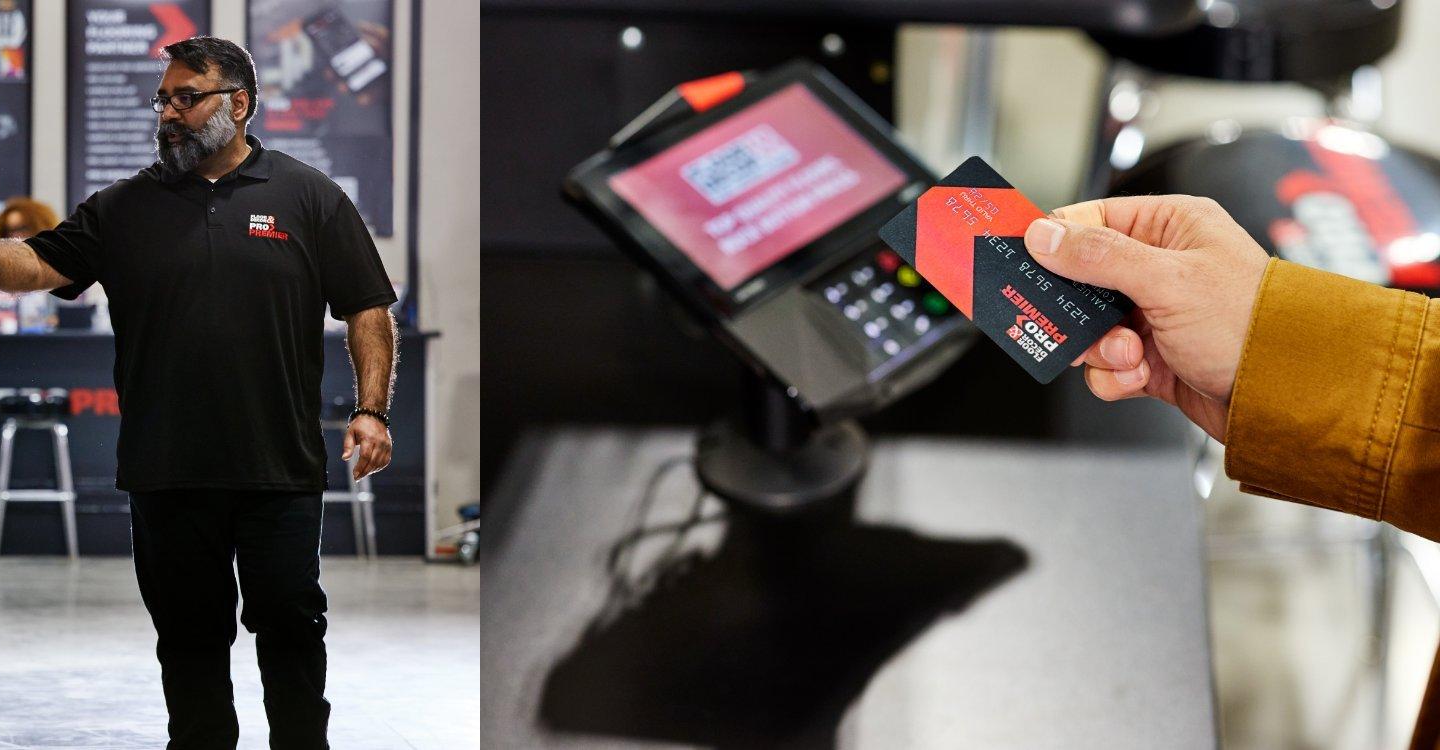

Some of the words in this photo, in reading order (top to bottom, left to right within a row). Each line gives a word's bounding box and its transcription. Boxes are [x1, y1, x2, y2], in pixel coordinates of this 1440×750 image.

[945, 196, 978, 226] 5678
[959, 191, 976, 206] THRU
[975, 205, 993, 222] VALID
[249, 222, 270, 231] PRO
[249, 229, 289, 241] PREMIER
[982, 229, 1015, 259] 1234
[1018, 260, 1052, 291] 5678
[1000, 284, 1067, 344] PREMIER
[1055, 294, 1090, 325] 1234
[1005, 323, 1024, 340] &
[1022, 319, 1058, 352] PRO
[1016, 337, 1043, 362] FLOOR
[1021, 333, 1048, 358] DECOR
